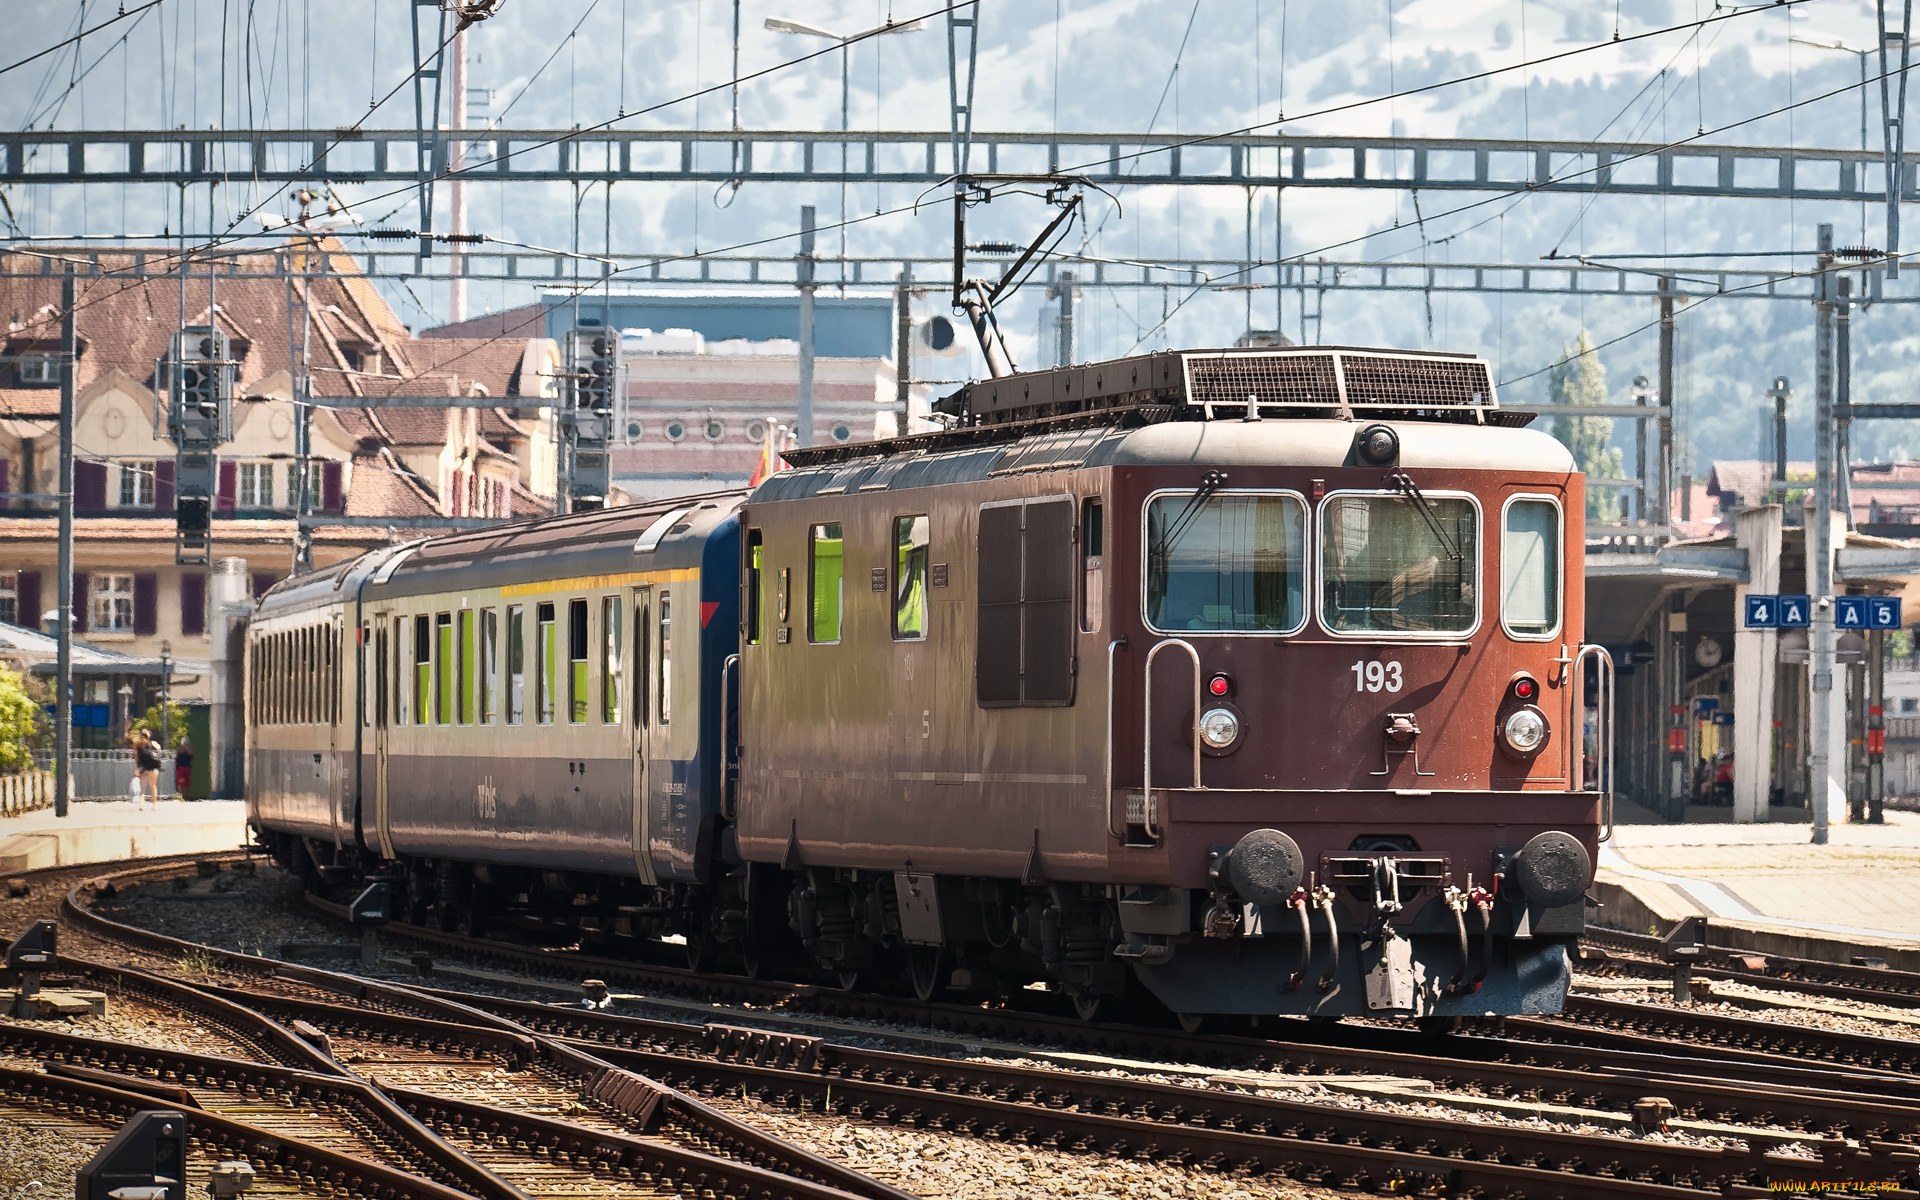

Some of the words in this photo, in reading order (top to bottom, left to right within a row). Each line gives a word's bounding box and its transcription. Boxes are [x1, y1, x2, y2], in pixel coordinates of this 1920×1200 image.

[1754, 604, 1769, 622] 4
[1786, 605, 1802, 623] A
[1844, 606, 1859, 624] A
[1878, 606, 1892, 625] 5
[1351, 660, 1404, 693] 193
